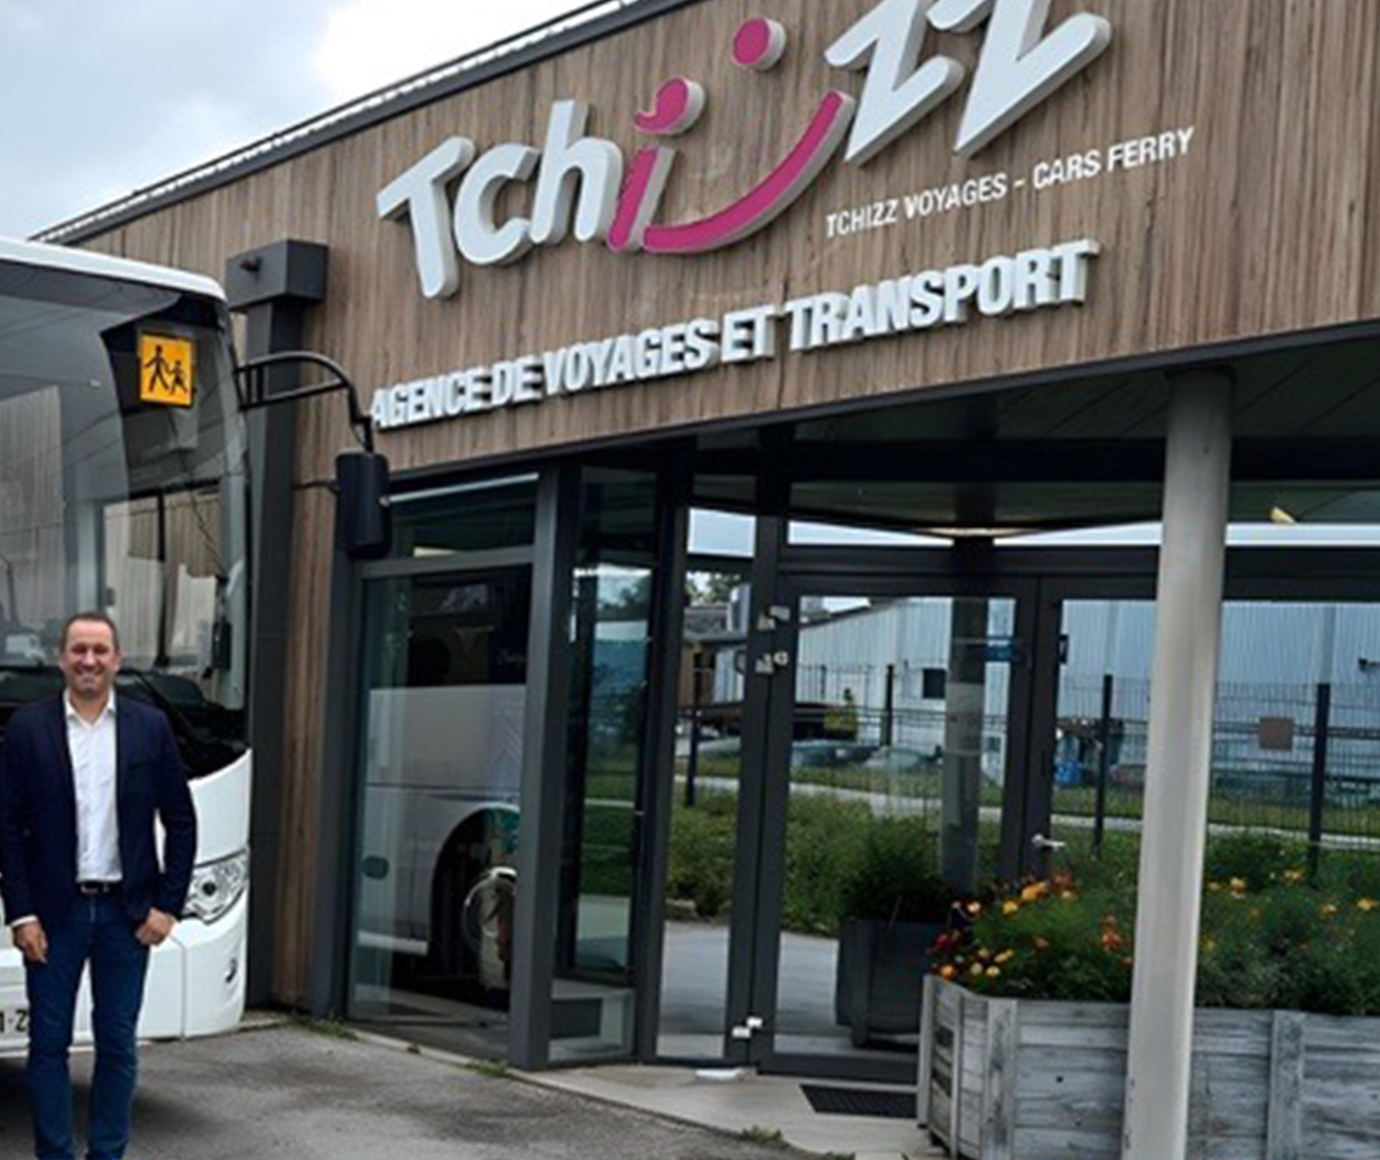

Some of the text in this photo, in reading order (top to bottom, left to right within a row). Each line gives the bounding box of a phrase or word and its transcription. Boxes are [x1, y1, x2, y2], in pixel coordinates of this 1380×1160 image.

[825, 198, 899, 238] TCHIZZ
[904, 171, 1007, 220] VOYAGES
[1033, 149, 1102, 189] CARS
[1106, 126, 1195, 172] FERRY
[372, 237, 1101, 430] AGENCE DE VOYAGES ET TRANSPORT
